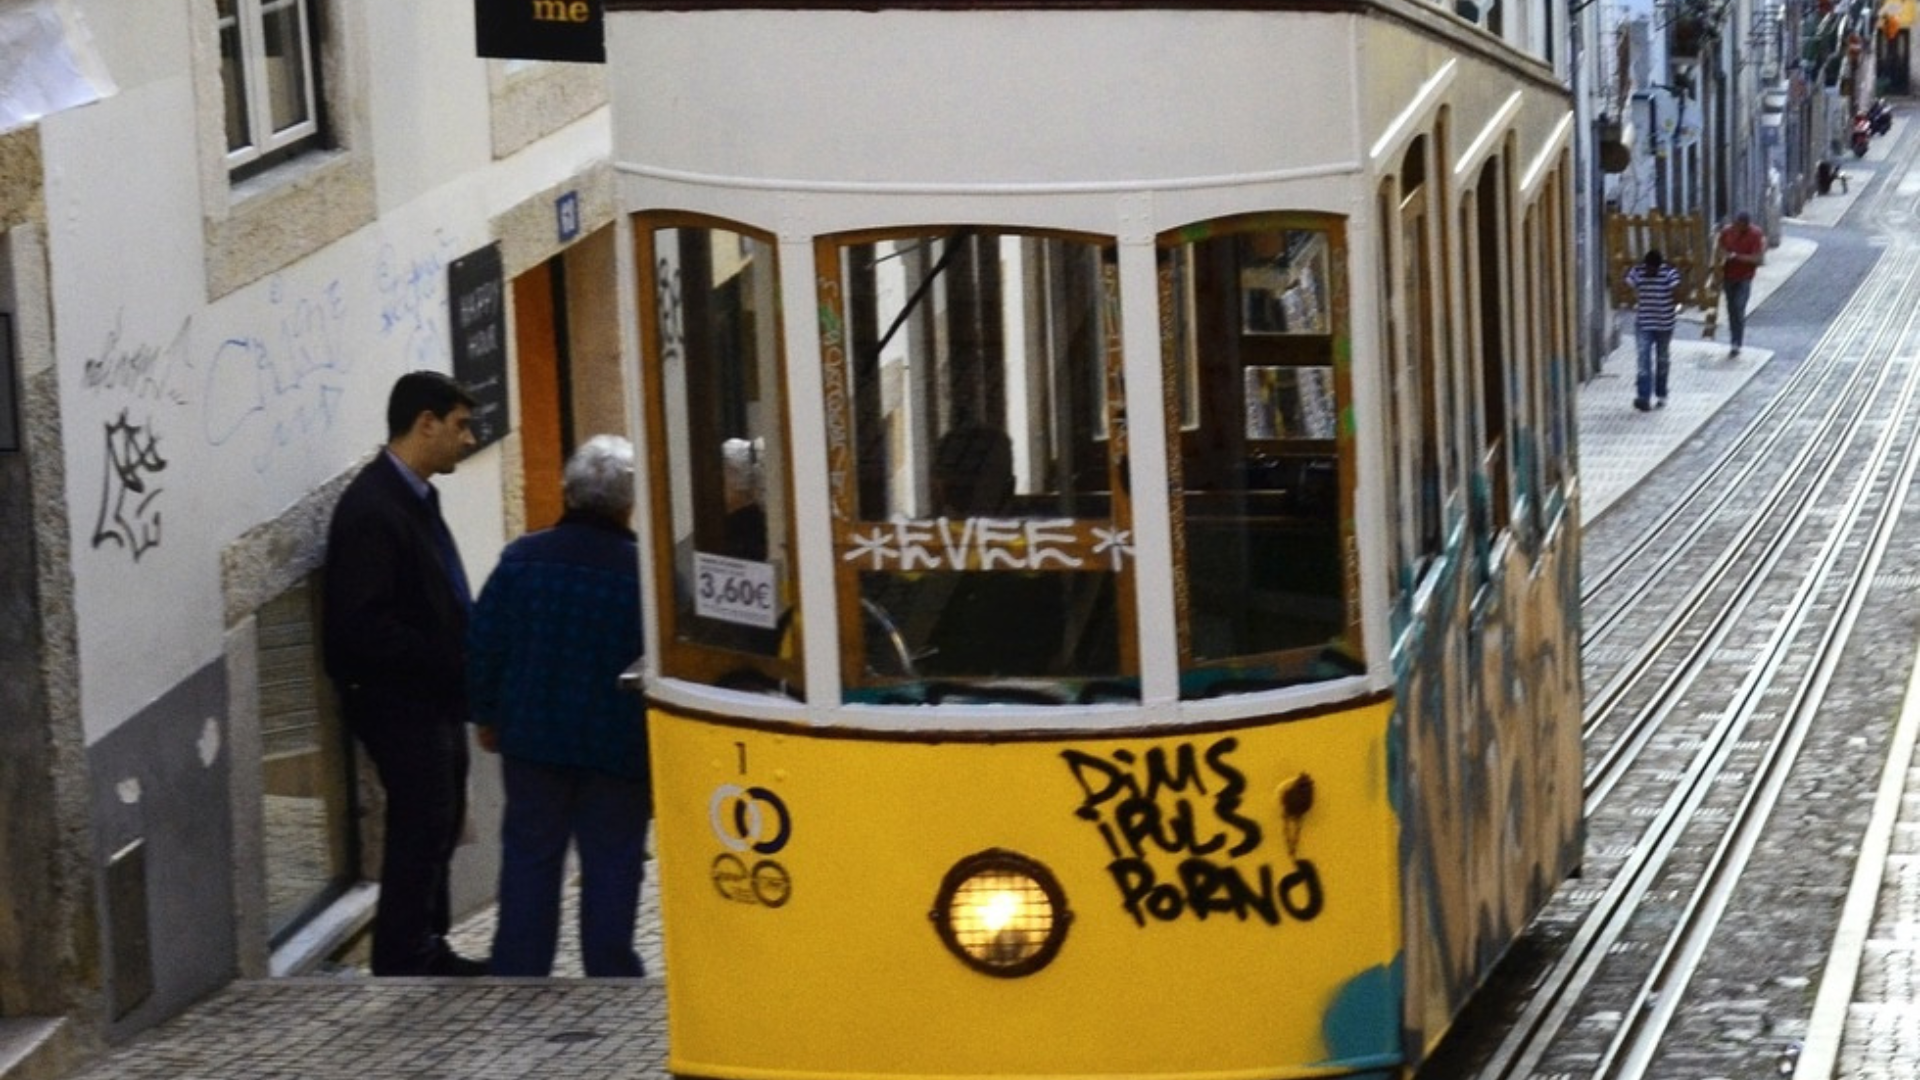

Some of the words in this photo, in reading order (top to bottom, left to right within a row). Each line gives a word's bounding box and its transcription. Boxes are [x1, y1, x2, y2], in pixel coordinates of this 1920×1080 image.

[531, 0, 589, 23] me
[700, 572, 771, 610] 3,60€
[734, 741, 747, 775] 1
